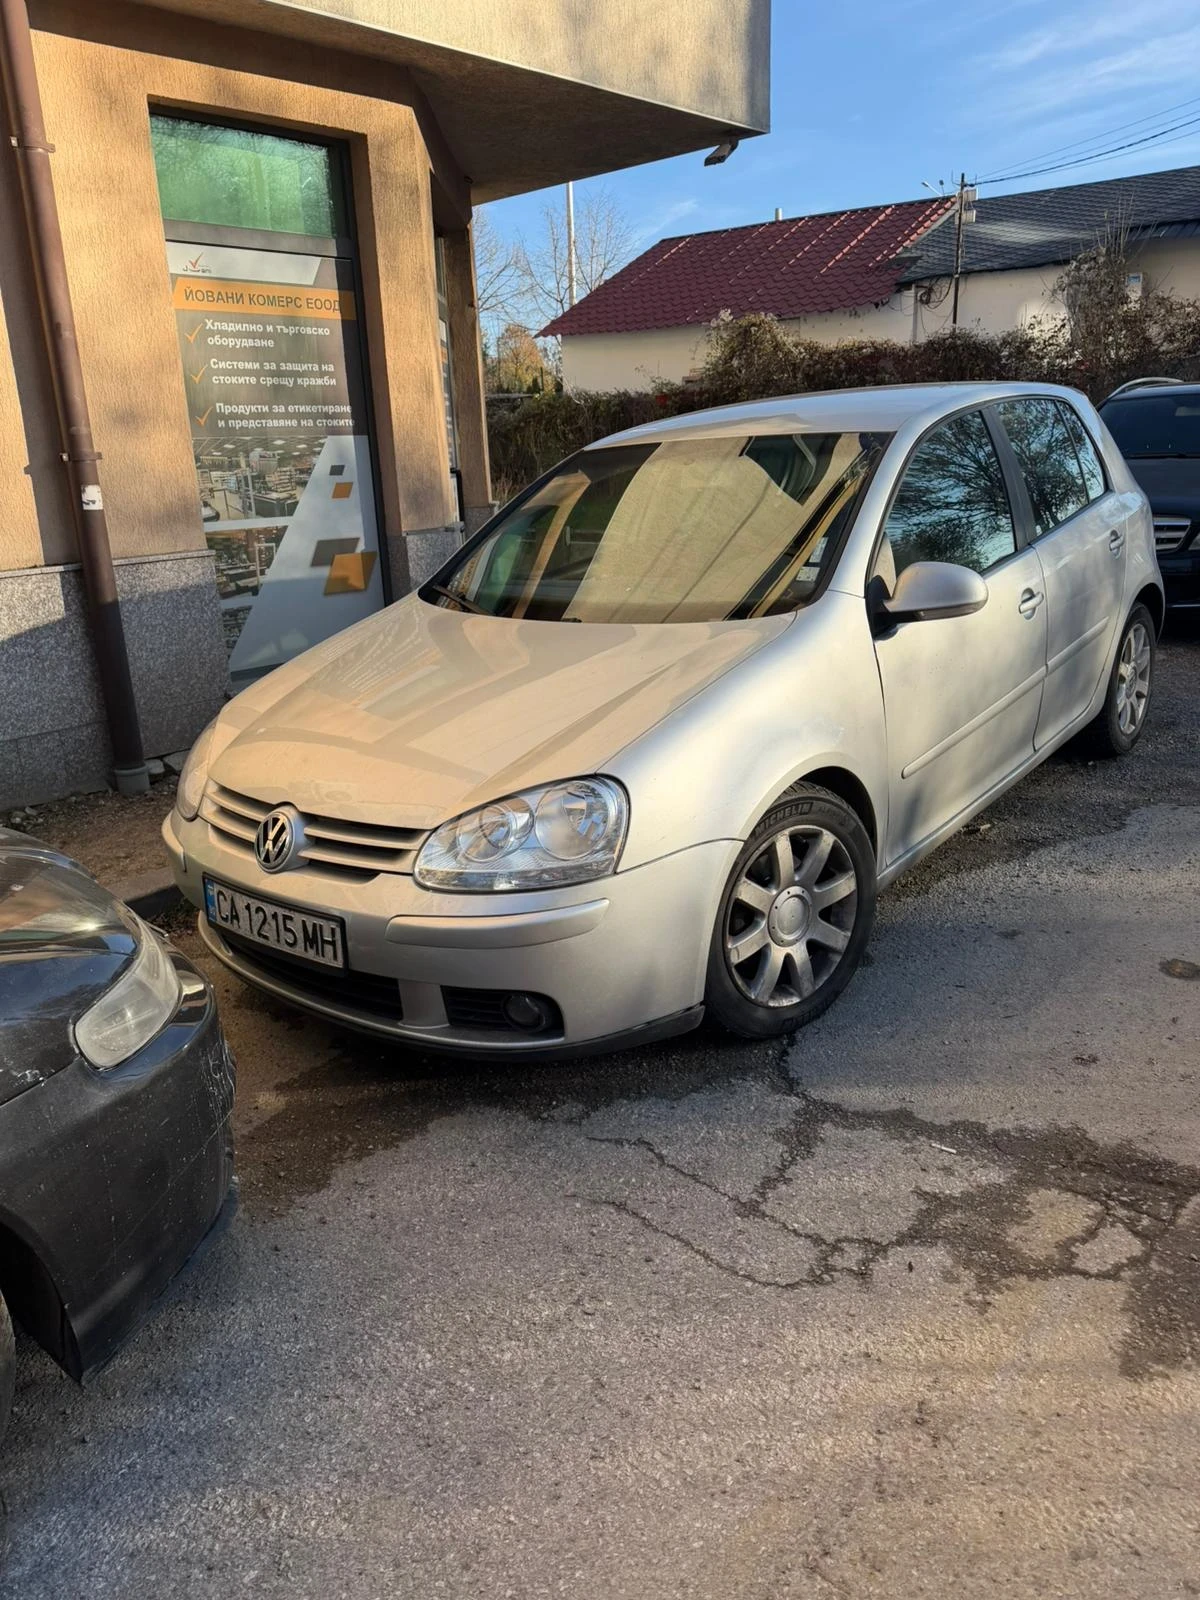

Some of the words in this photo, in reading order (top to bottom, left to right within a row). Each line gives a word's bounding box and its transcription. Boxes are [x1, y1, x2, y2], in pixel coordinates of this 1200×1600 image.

[184, 287, 245, 305] ЙОВАНИ
[249, 293, 303, 309] КОМЕРС
[306, 297, 341, 313] ЕООД
[205, 318, 263, 333] Хладилно
[266, 325, 273, 333] и
[276, 325, 330, 337] търговско
[207, 336, 275, 348] оборудване
[210, 358, 260, 370] Системи
[263, 361, 276, 370] за
[280, 362, 319, 373] защита
[322, 363, 335, 372] на
[212, 375, 256, 385] стоките
[260, 376, 294, 388] срещу
[297, 375, 337, 387] кражби
[215, 402, 269, 415] Продукти
[272, 404, 285, 413] за
[288, 404, 352, 415] етикетиране
[218, 419, 225, 428] и
[228, 419, 298, 430] представяне
[301, 418, 314, 427] на
[216, 889, 241, 929] CA
[244, 902, 298, 948] 1215
[301, 919, 338, 962] MH
